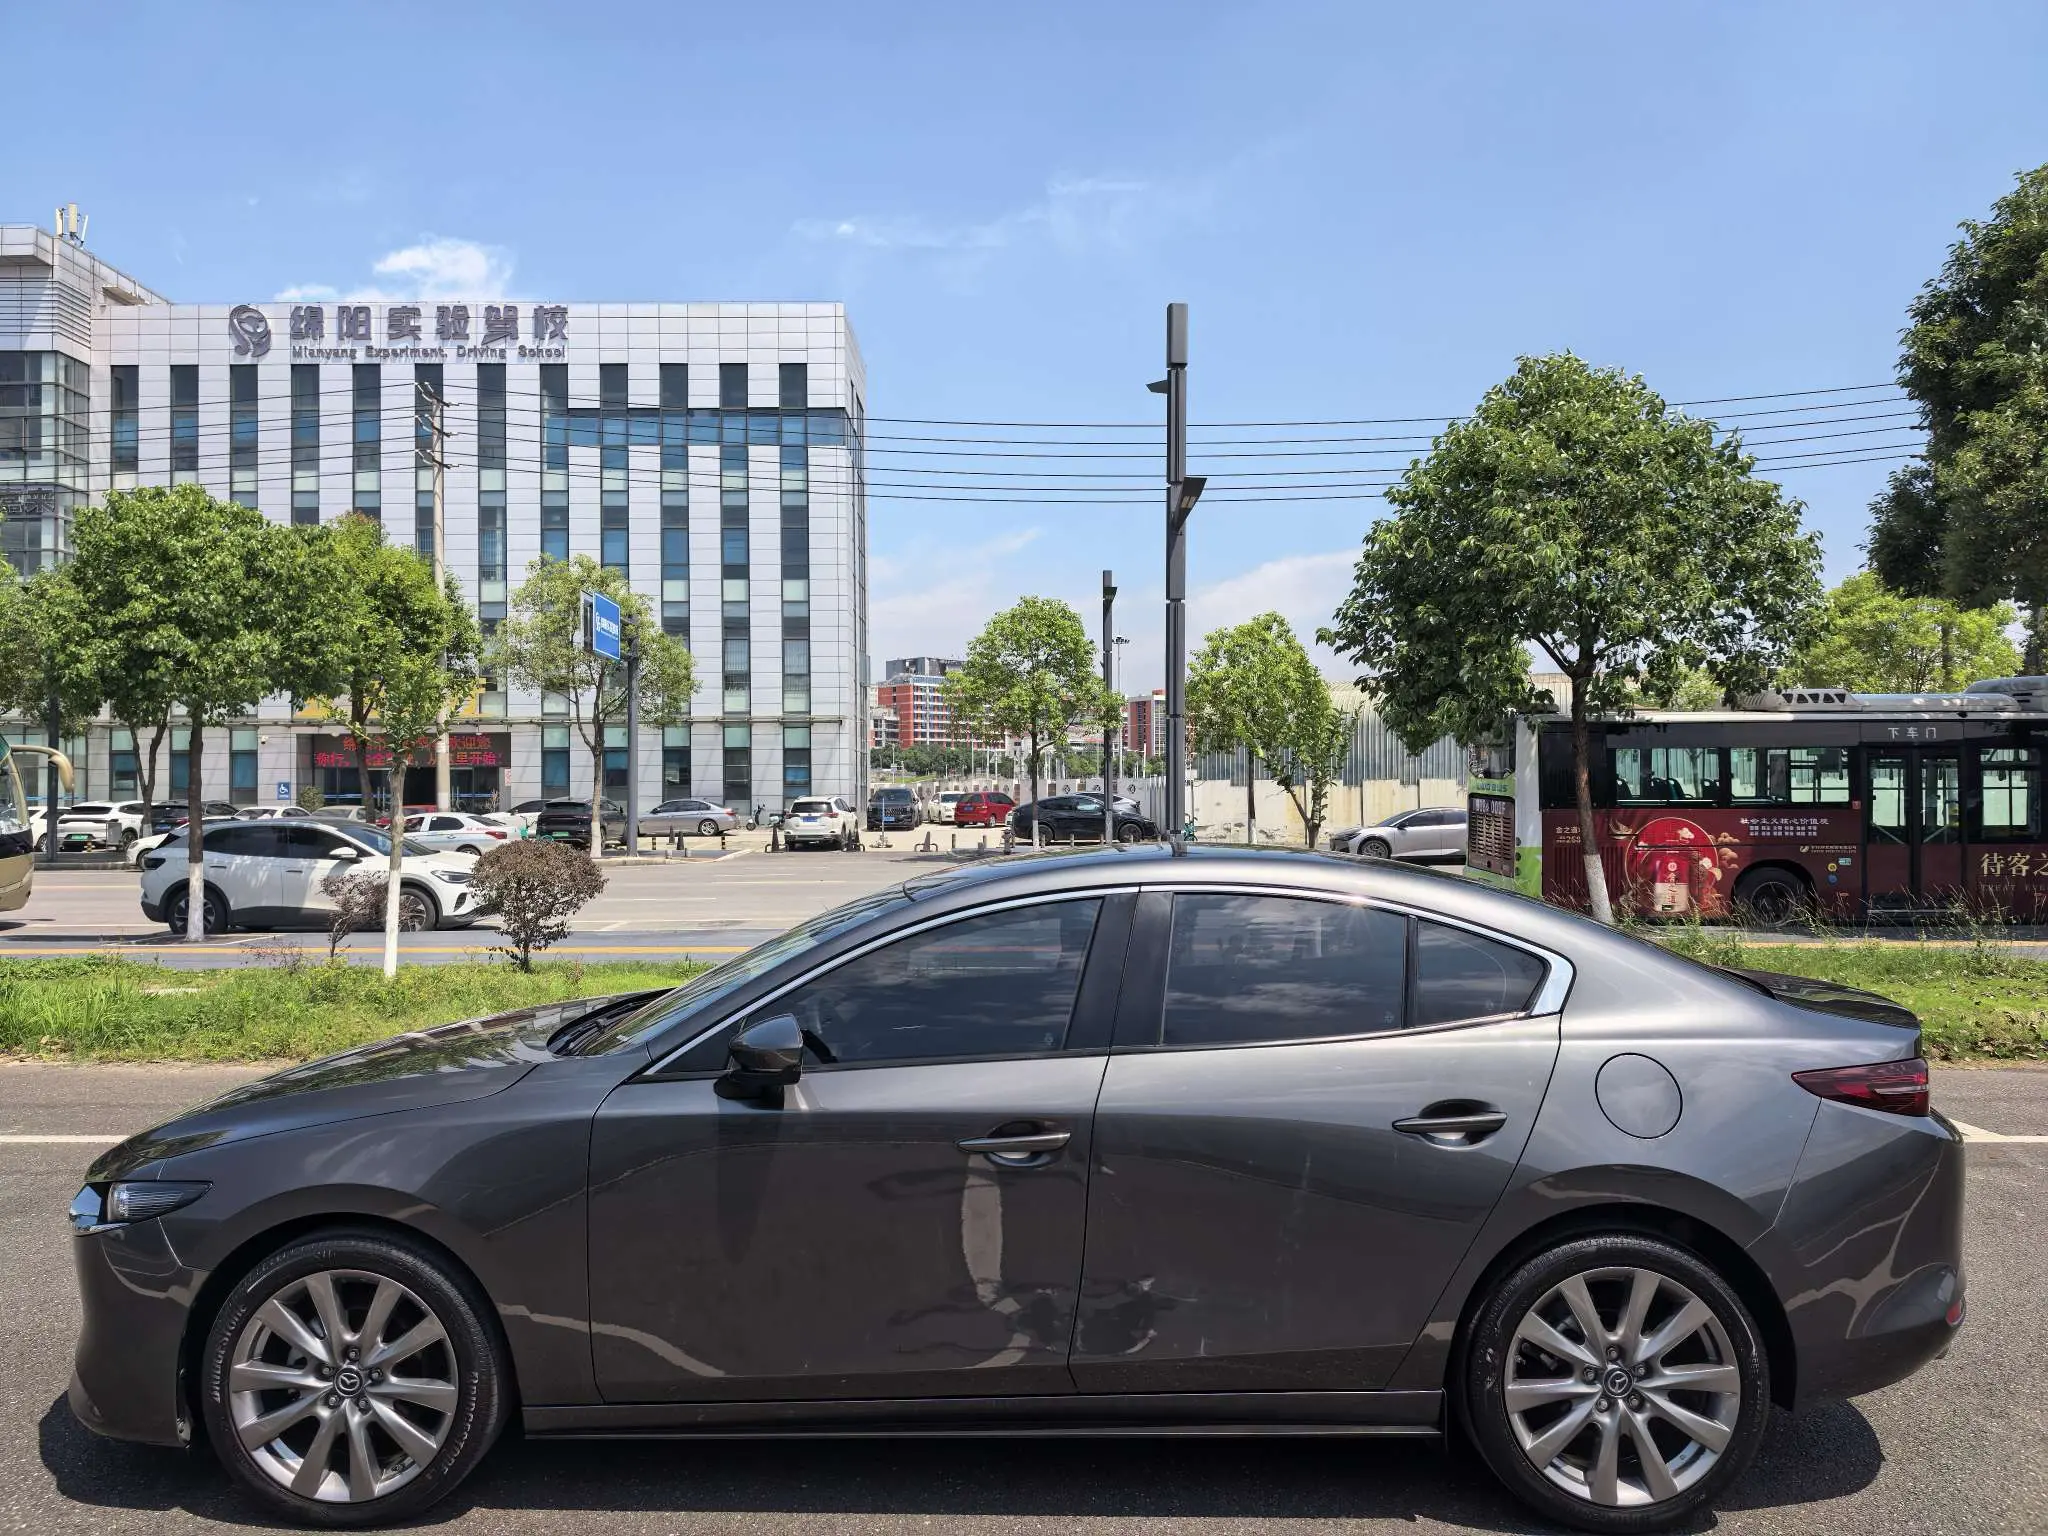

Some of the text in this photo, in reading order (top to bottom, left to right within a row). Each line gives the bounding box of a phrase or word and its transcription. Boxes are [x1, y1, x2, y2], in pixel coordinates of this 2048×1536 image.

[290, 304, 569, 346] 绵阳实验驾校
[292, 345, 357, 360] Mianyang
[457, 344, 507, 359] Driving
[518, 344, 565, 358] School
[1887, 726, 1936, 739] 下车门
[1739, 817, 1830, 825] 社会主义核心价值观
[1980, 852, 2048, 877] 待客之
